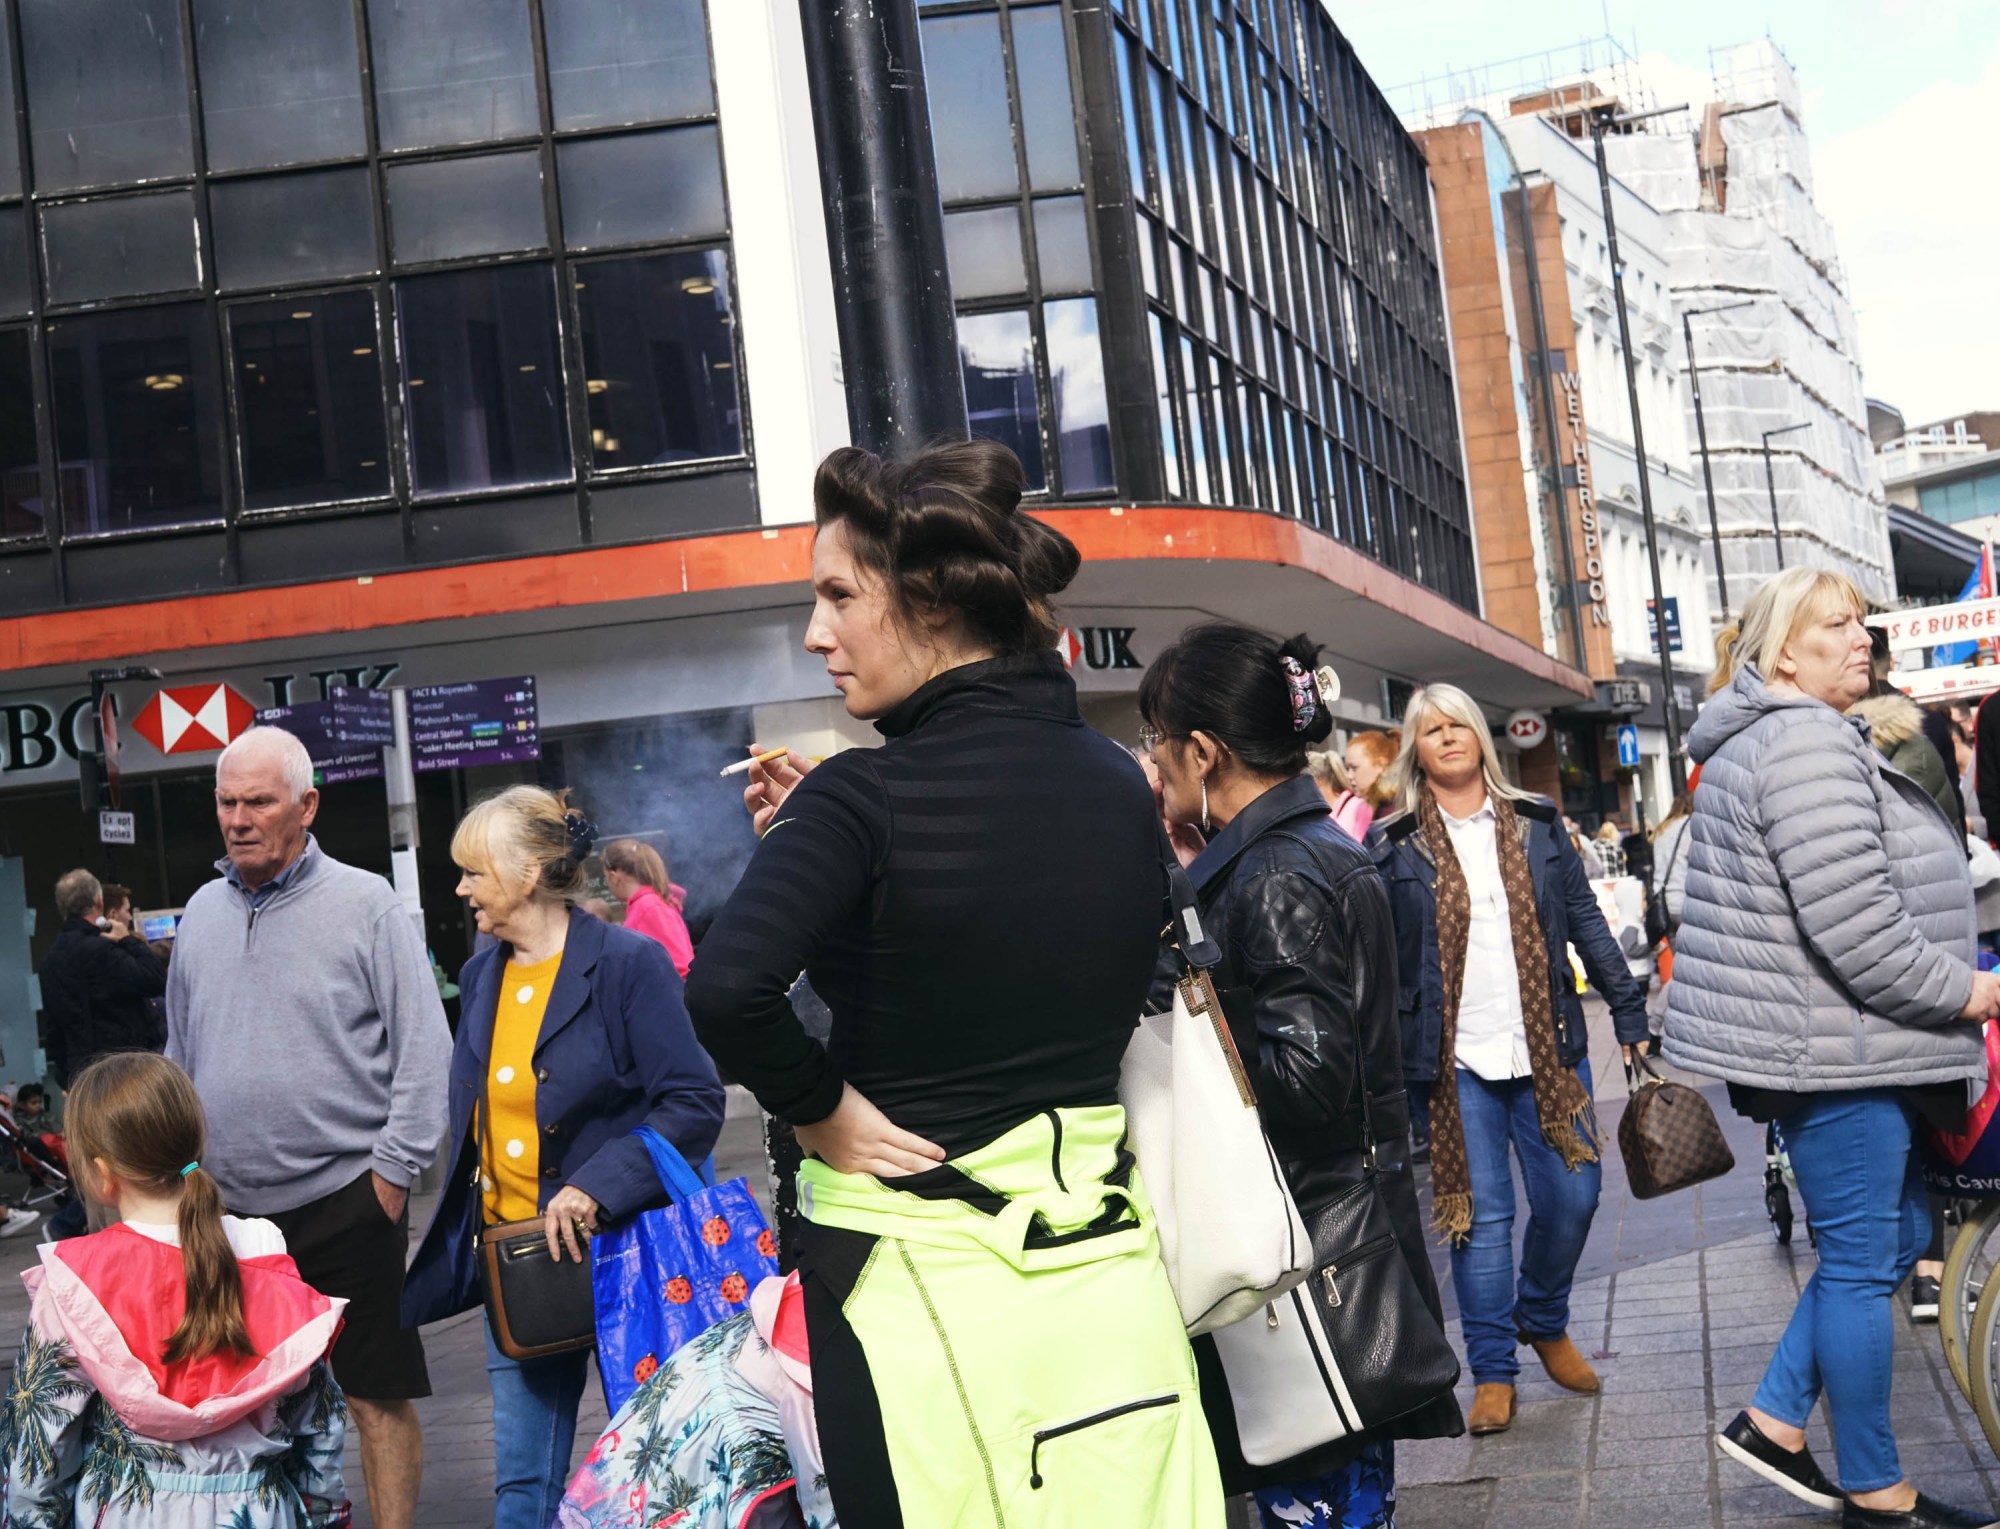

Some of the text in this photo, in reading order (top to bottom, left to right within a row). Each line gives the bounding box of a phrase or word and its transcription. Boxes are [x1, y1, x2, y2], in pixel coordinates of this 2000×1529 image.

[1560, 372, 1609, 627] WETHERSPOON
[1909, 620, 1921, 637] &
[1927, 608, 2000, 635] BURGE
[1078, 626, 1144, 670] UK
[412, 687, 430, 698] FACT
[0, 693, 121, 772] BC
[415, 731, 439, 742] Central
[440, 729, 464, 740] Station
[417, 738, 499, 754] uaker Meeting House
[335, 755, 343, 765] of
[344, 751, 377, 764] Liverpool
[417, 757, 459, 770] Bold Street
[326, 771, 346, 783] James
[355, 766, 379, 778] Station
[102, 814, 131, 826] Exept
[103, 828, 131, 840] cycles
